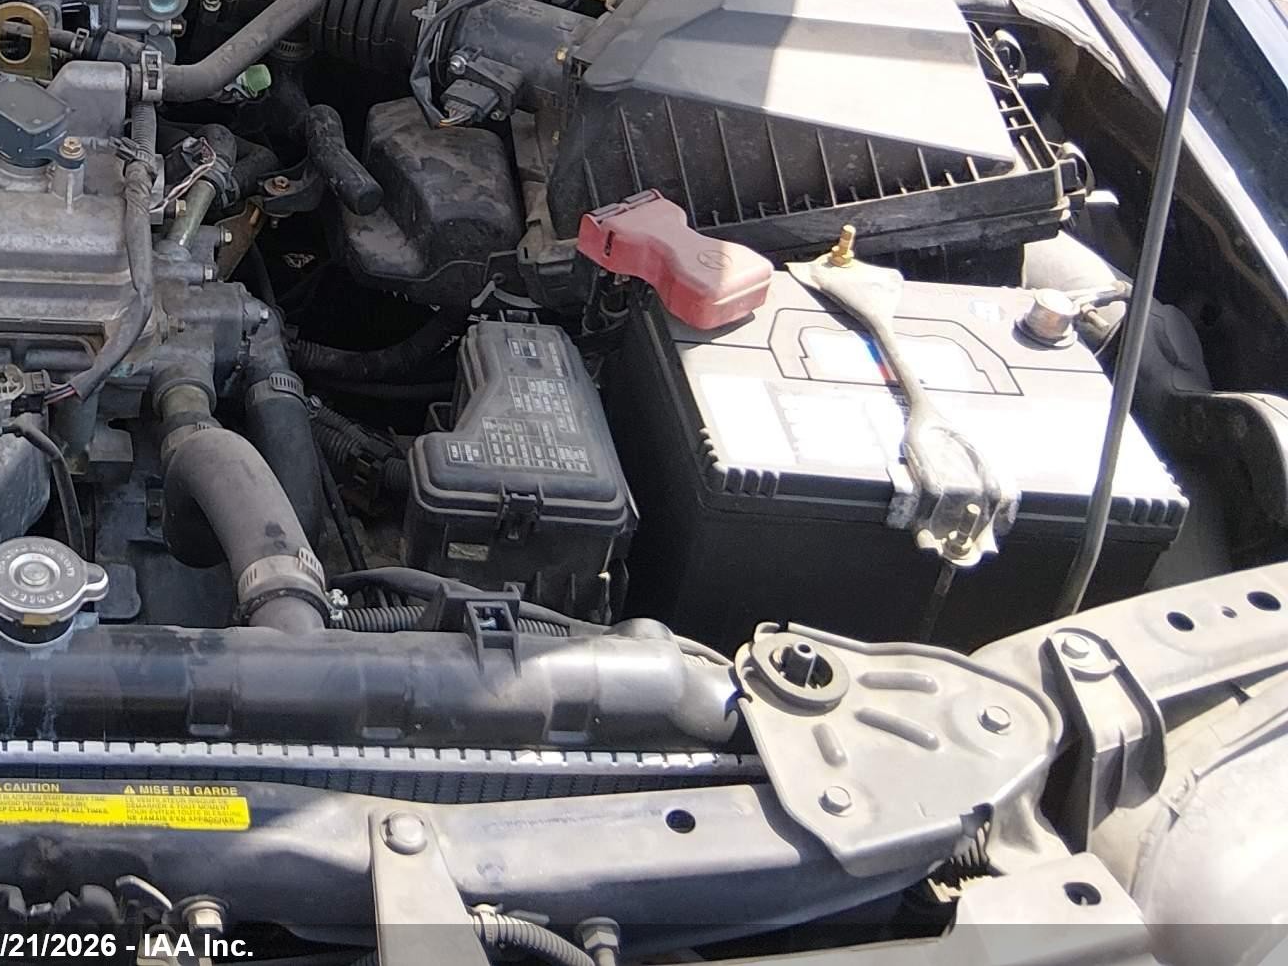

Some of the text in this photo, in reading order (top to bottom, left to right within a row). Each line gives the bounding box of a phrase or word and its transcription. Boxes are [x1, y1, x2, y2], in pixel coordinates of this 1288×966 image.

[3, 783, 60, 792] CAUTION
[139, 785, 238, 796] MISE EN GARDE
